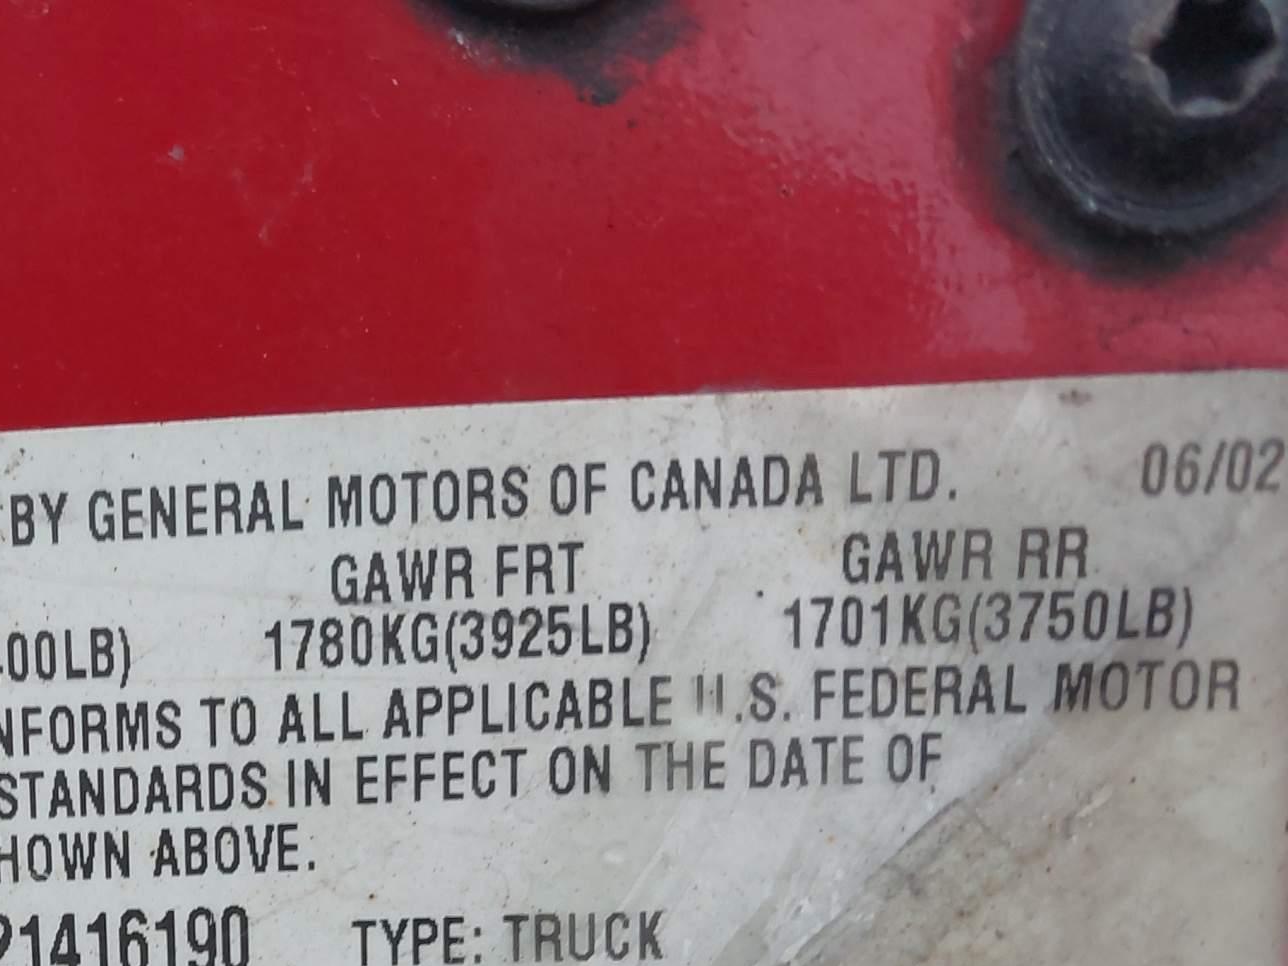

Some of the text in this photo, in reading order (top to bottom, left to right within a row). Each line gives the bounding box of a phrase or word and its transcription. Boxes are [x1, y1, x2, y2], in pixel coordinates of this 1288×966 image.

[11, 491, 68, 546] BY
[89, 479, 304, 542] GENERAL
[327, 467, 529, 528] MOTORS
[550, 462, 607, 515] OF
[631, 454, 824, 512] CANADA
[849, 448, 958, 502] LTD.
[1141, 437, 1285, 496] 06/02
[331, 542, 584, 605] GAWR FRT
[842, 526, 1089, 584] GAWR RR
[265, 602, 650, 672] 1780KG(3925LB)
[784, 586, 1193, 654] 1701KG(3750LB)
[200, 696, 256, 747] TO
[279, 691, 364, 745] ALL
[384, 675, 672, 739] APPLICABLE
[814, 664, 1027, 719] FEDERAL
[1053, 659, 1239, 713] MOTOR
[288, 757, 331, 807] IN
[357, 748, 527, 804] EFFECT
[549, 744, 611, 794] ON
[635, 740, 726, 792] THE
[749, 733, 864, 790] DATE
[888, 732, 943, 784] OF
[153, 823, 316, 878] ABOVE.
[503, 910, 663, 963] TRUCK
